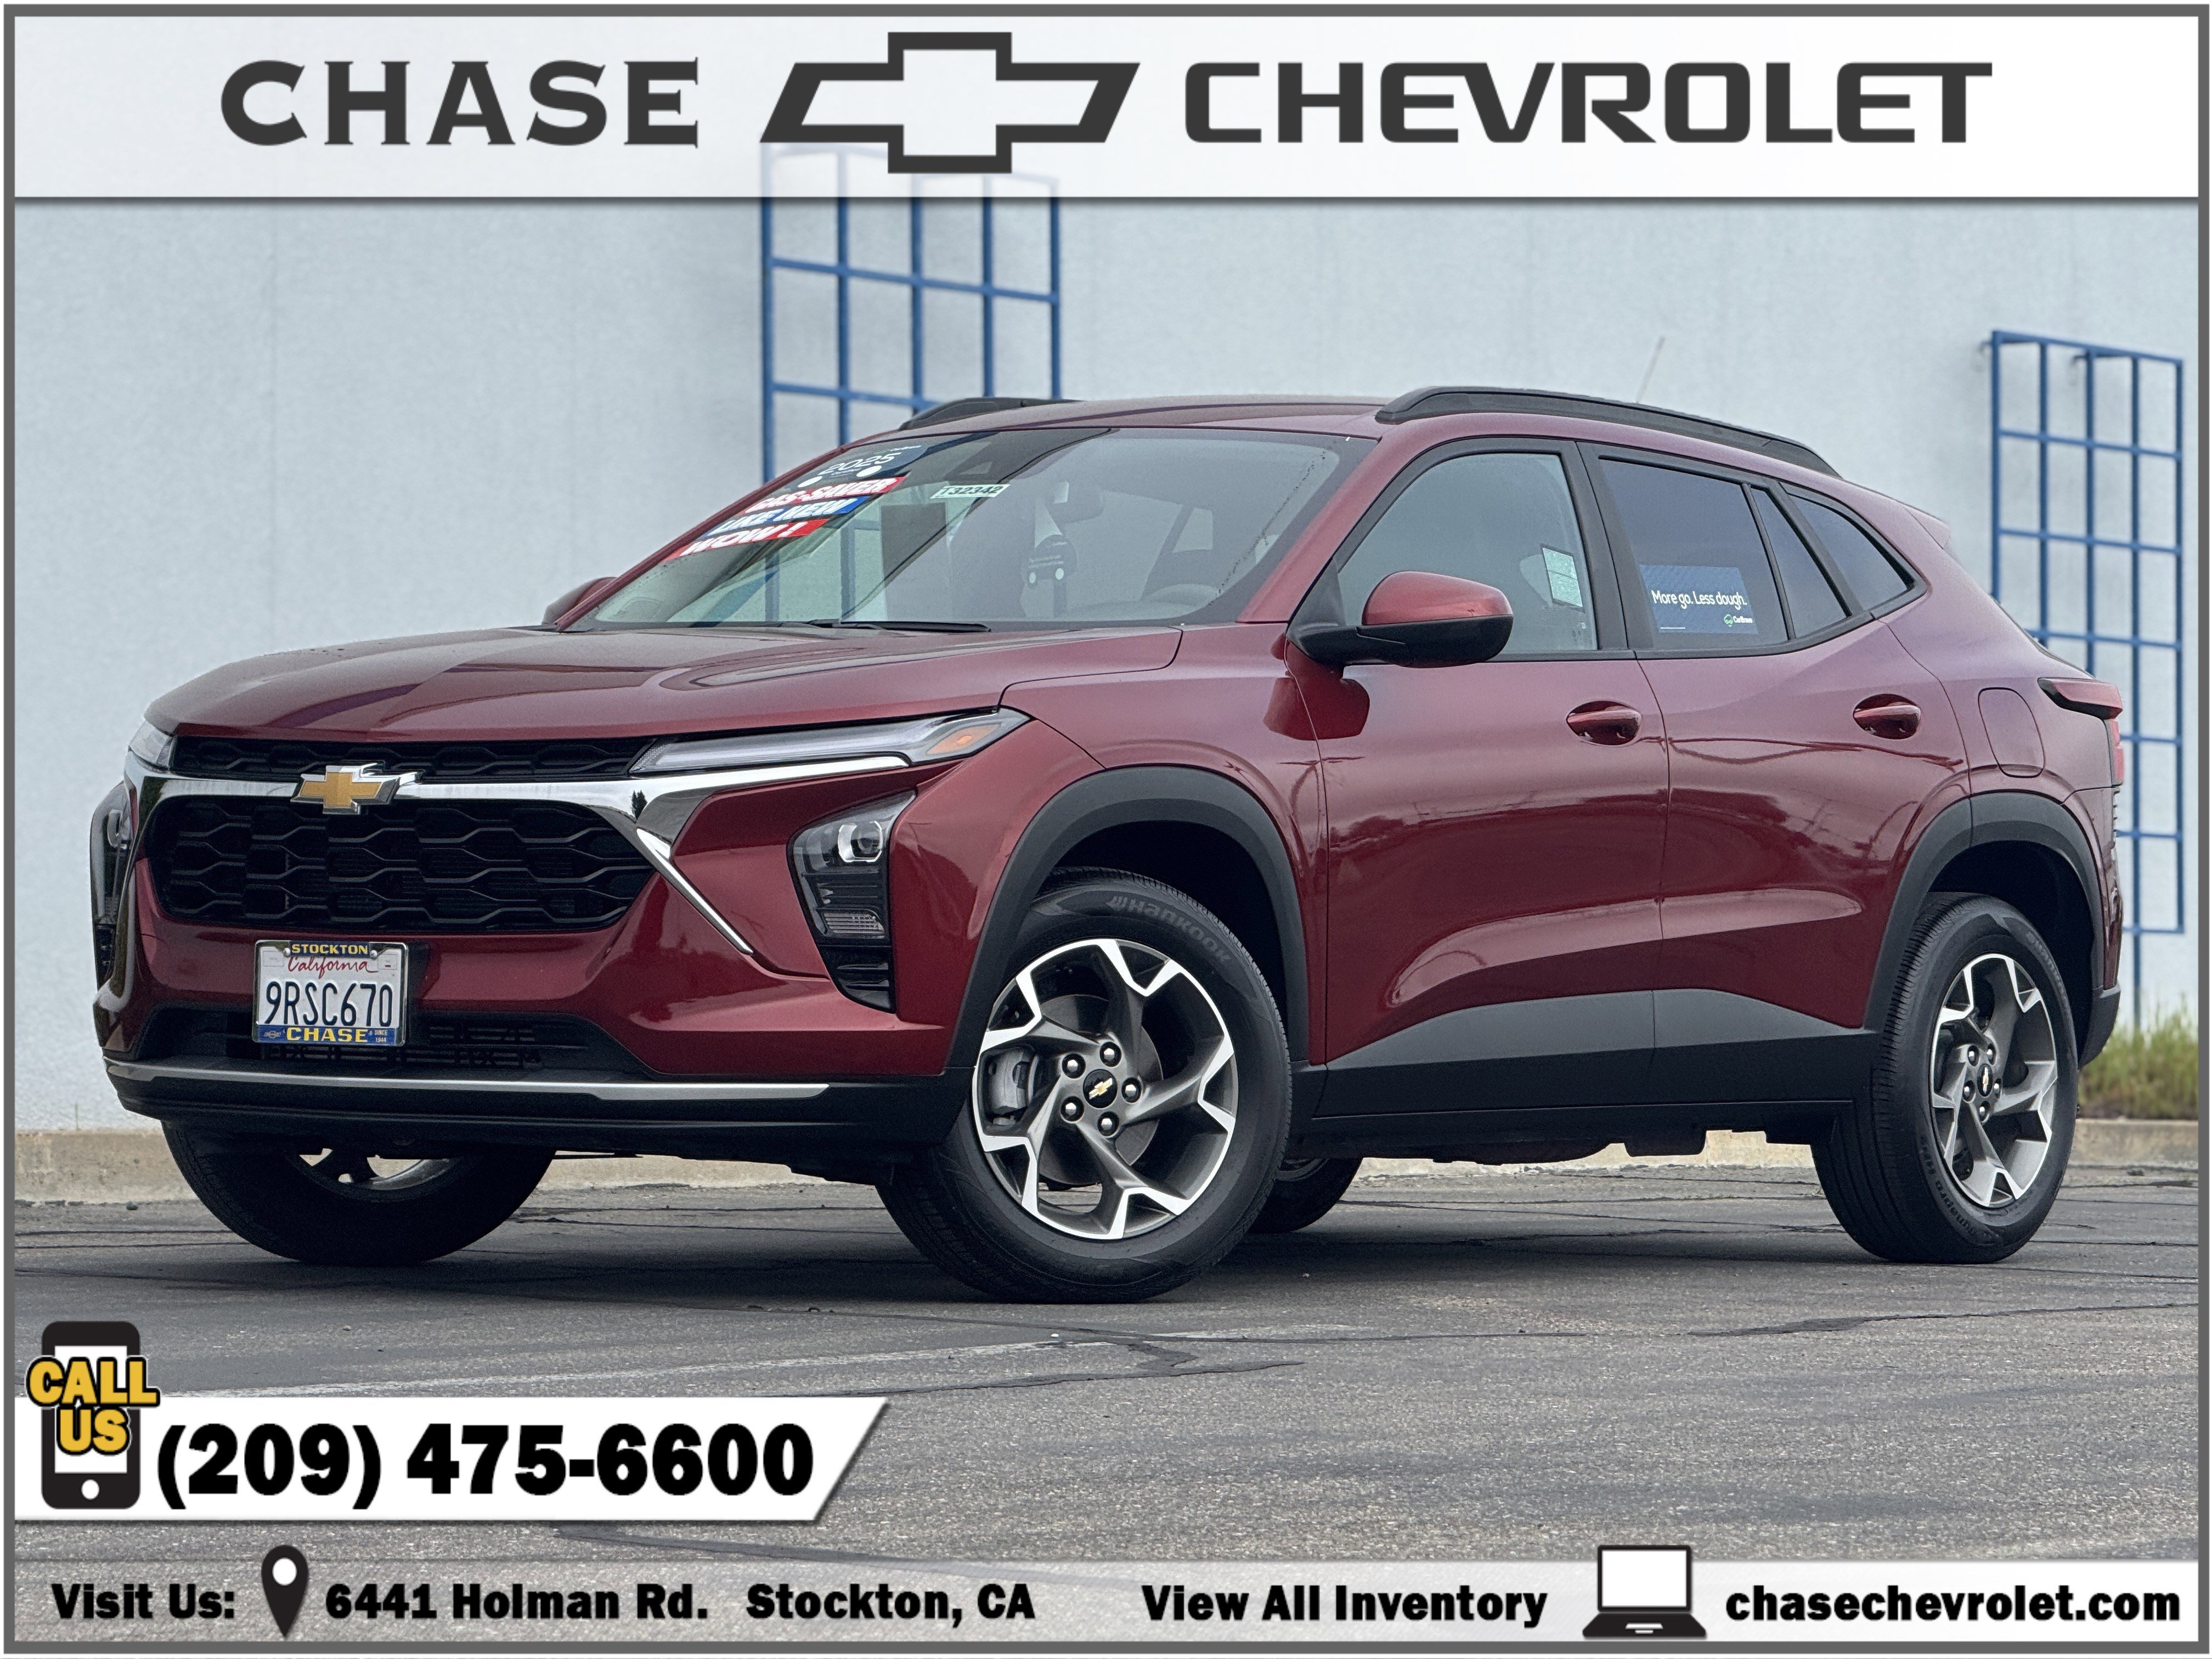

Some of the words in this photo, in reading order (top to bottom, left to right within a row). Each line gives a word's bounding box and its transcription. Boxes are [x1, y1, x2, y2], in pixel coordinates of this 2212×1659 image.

[817, 452, 902, 476] 2025
[745, 478, 898, 514] GAS-SAVER
[772, 498, 859, 522] NEW
[1651, 590, 1678, 605] More
[1678, 593, 1694, 610] go.
[1692, 591, 1716, 605] Less
[1716, 591, 1748, 611] dough.
[292, 944, 368, 955] STOCKTON
[287, 956, 379, 979] California
[264, 981, 393, 1027] 9RSC670
[286, 1027, 369, 1042] CHASE
